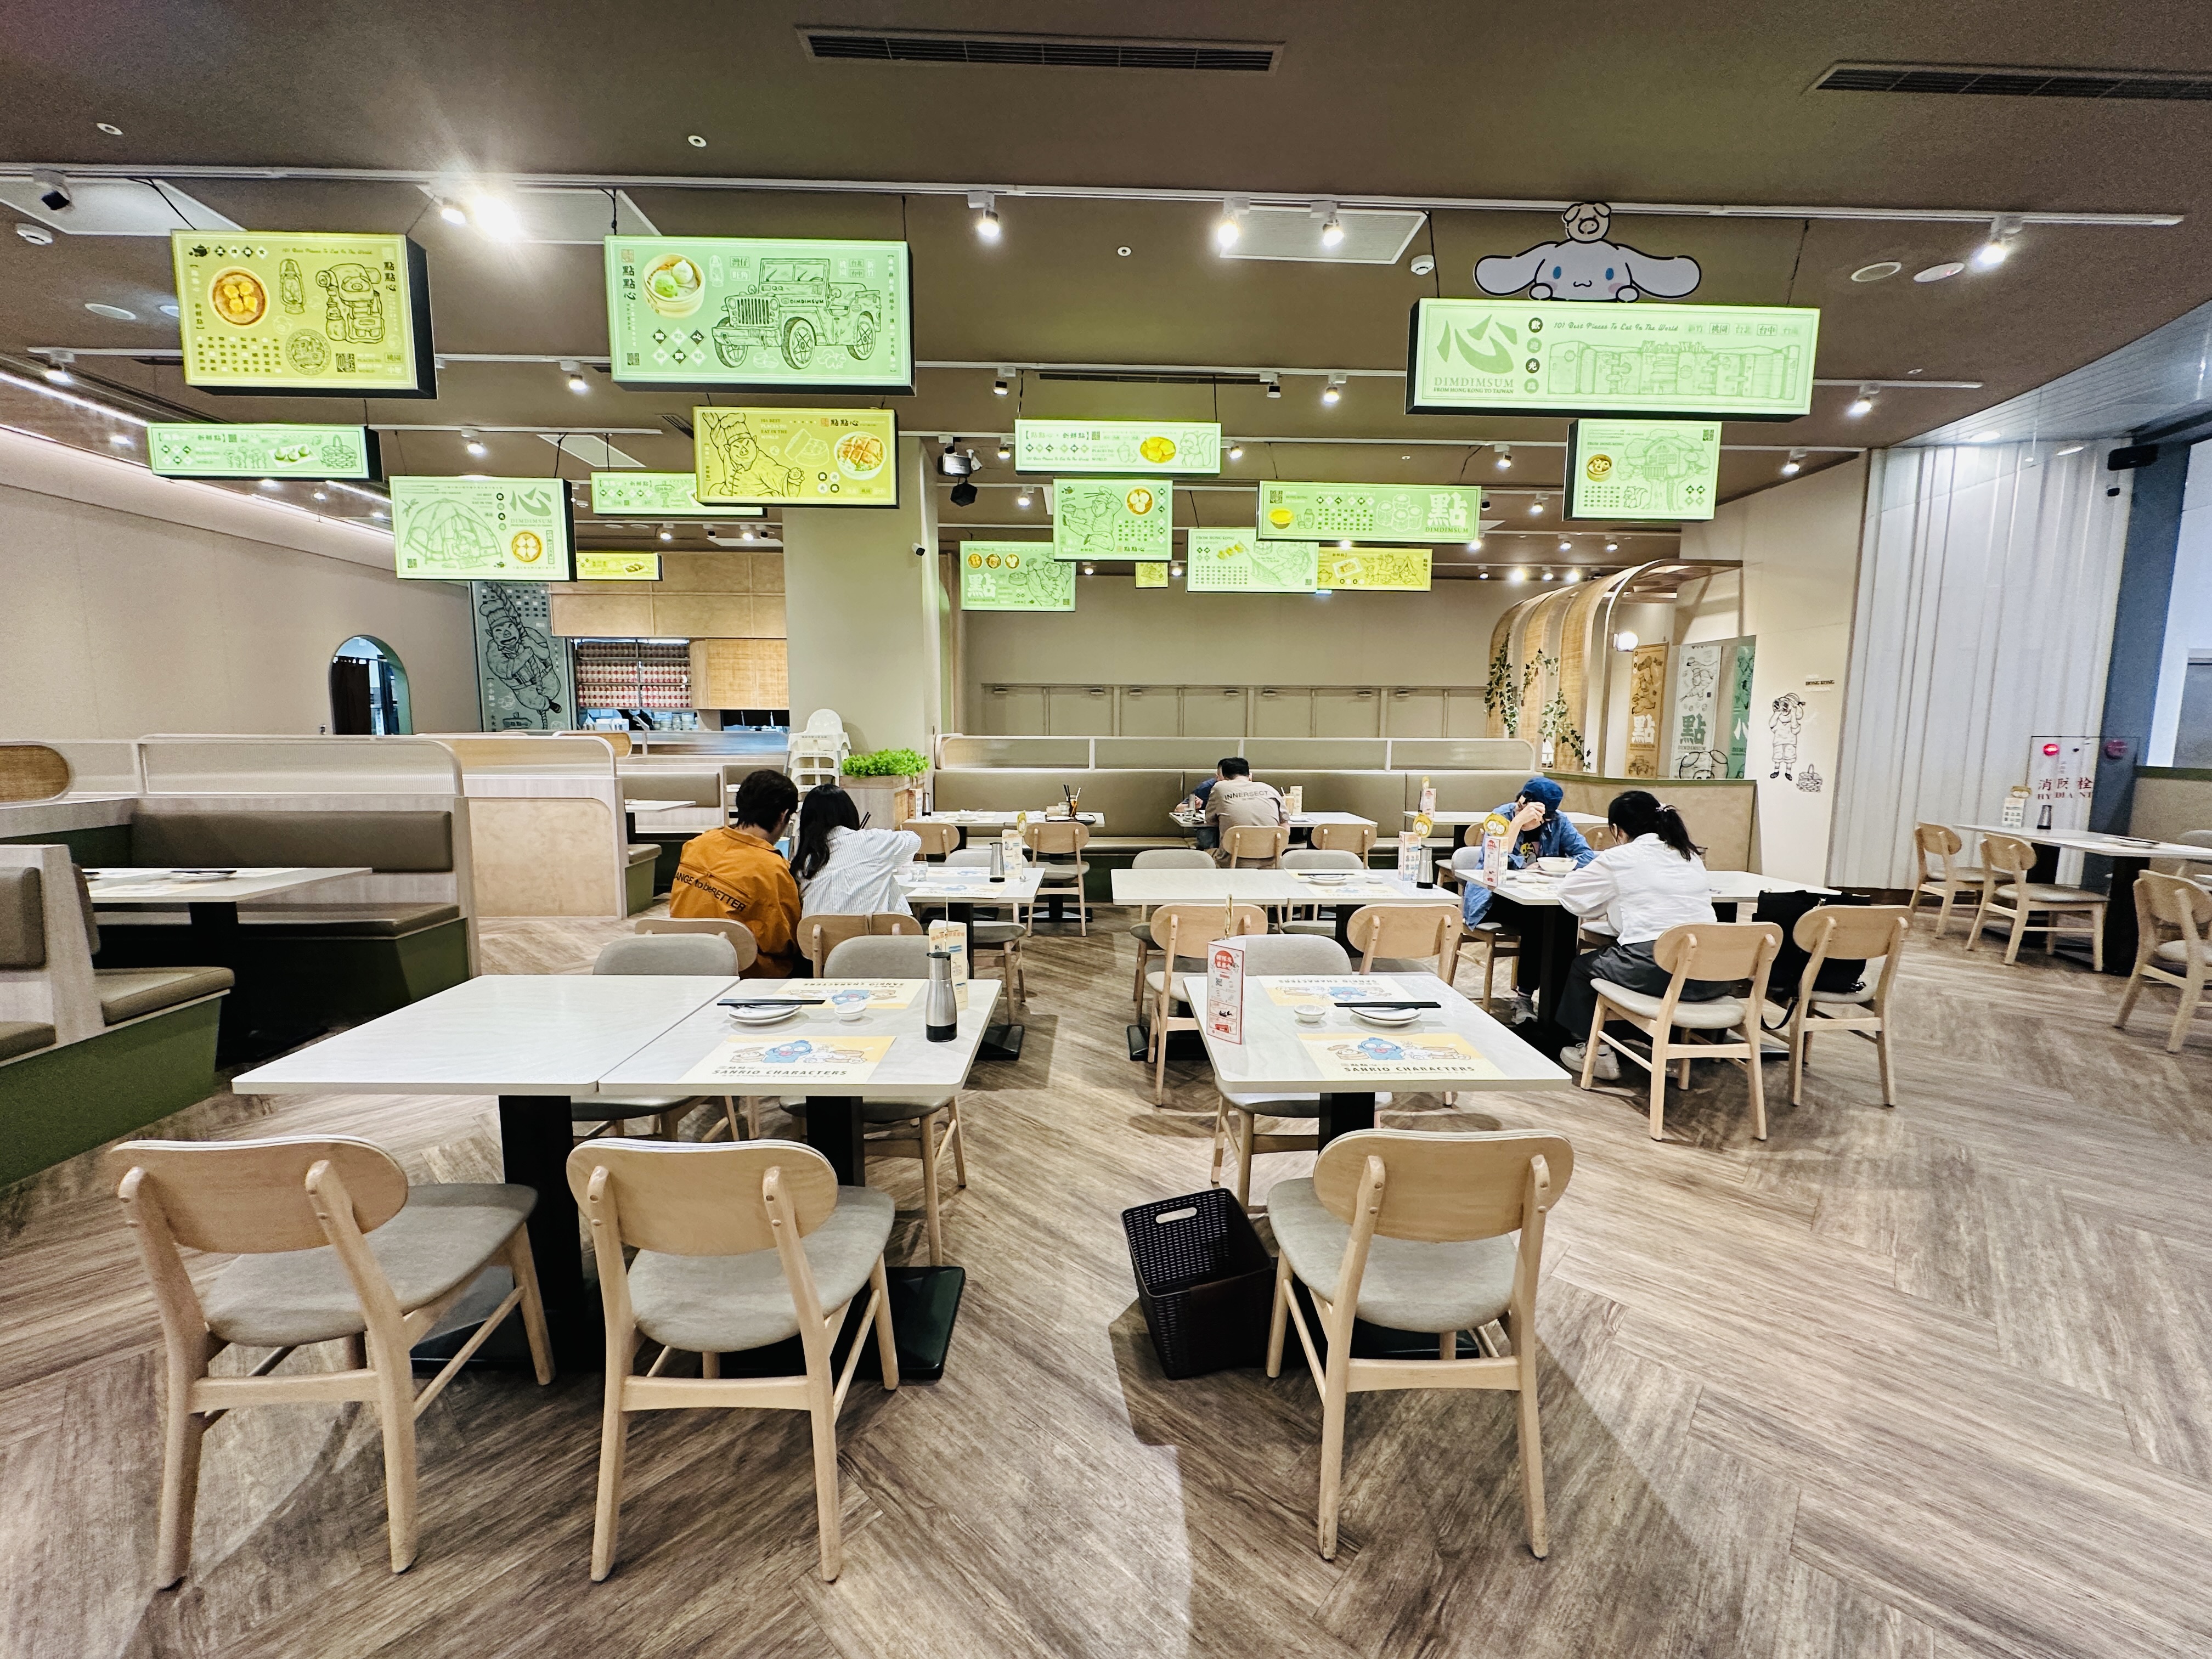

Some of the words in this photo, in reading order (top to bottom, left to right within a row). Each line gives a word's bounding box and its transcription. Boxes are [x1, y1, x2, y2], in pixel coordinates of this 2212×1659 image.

[622, 265, 636, 300] 點點心
[1434, 377, 1514, 387] DIMDIMSUM
[1427, 492, 1468, 527] 點
[967, 573, 997, 598] 點
[1632, 714, 1656, 744] 點
[1680, 713, 1706, 744] 點
[1224, 791, 1268, 800] INNERSECT
[2038, 777, 2093, 791] 消防栓
[675, 872, 694, 885] ANGE
[695, 879, 703, 888] to
